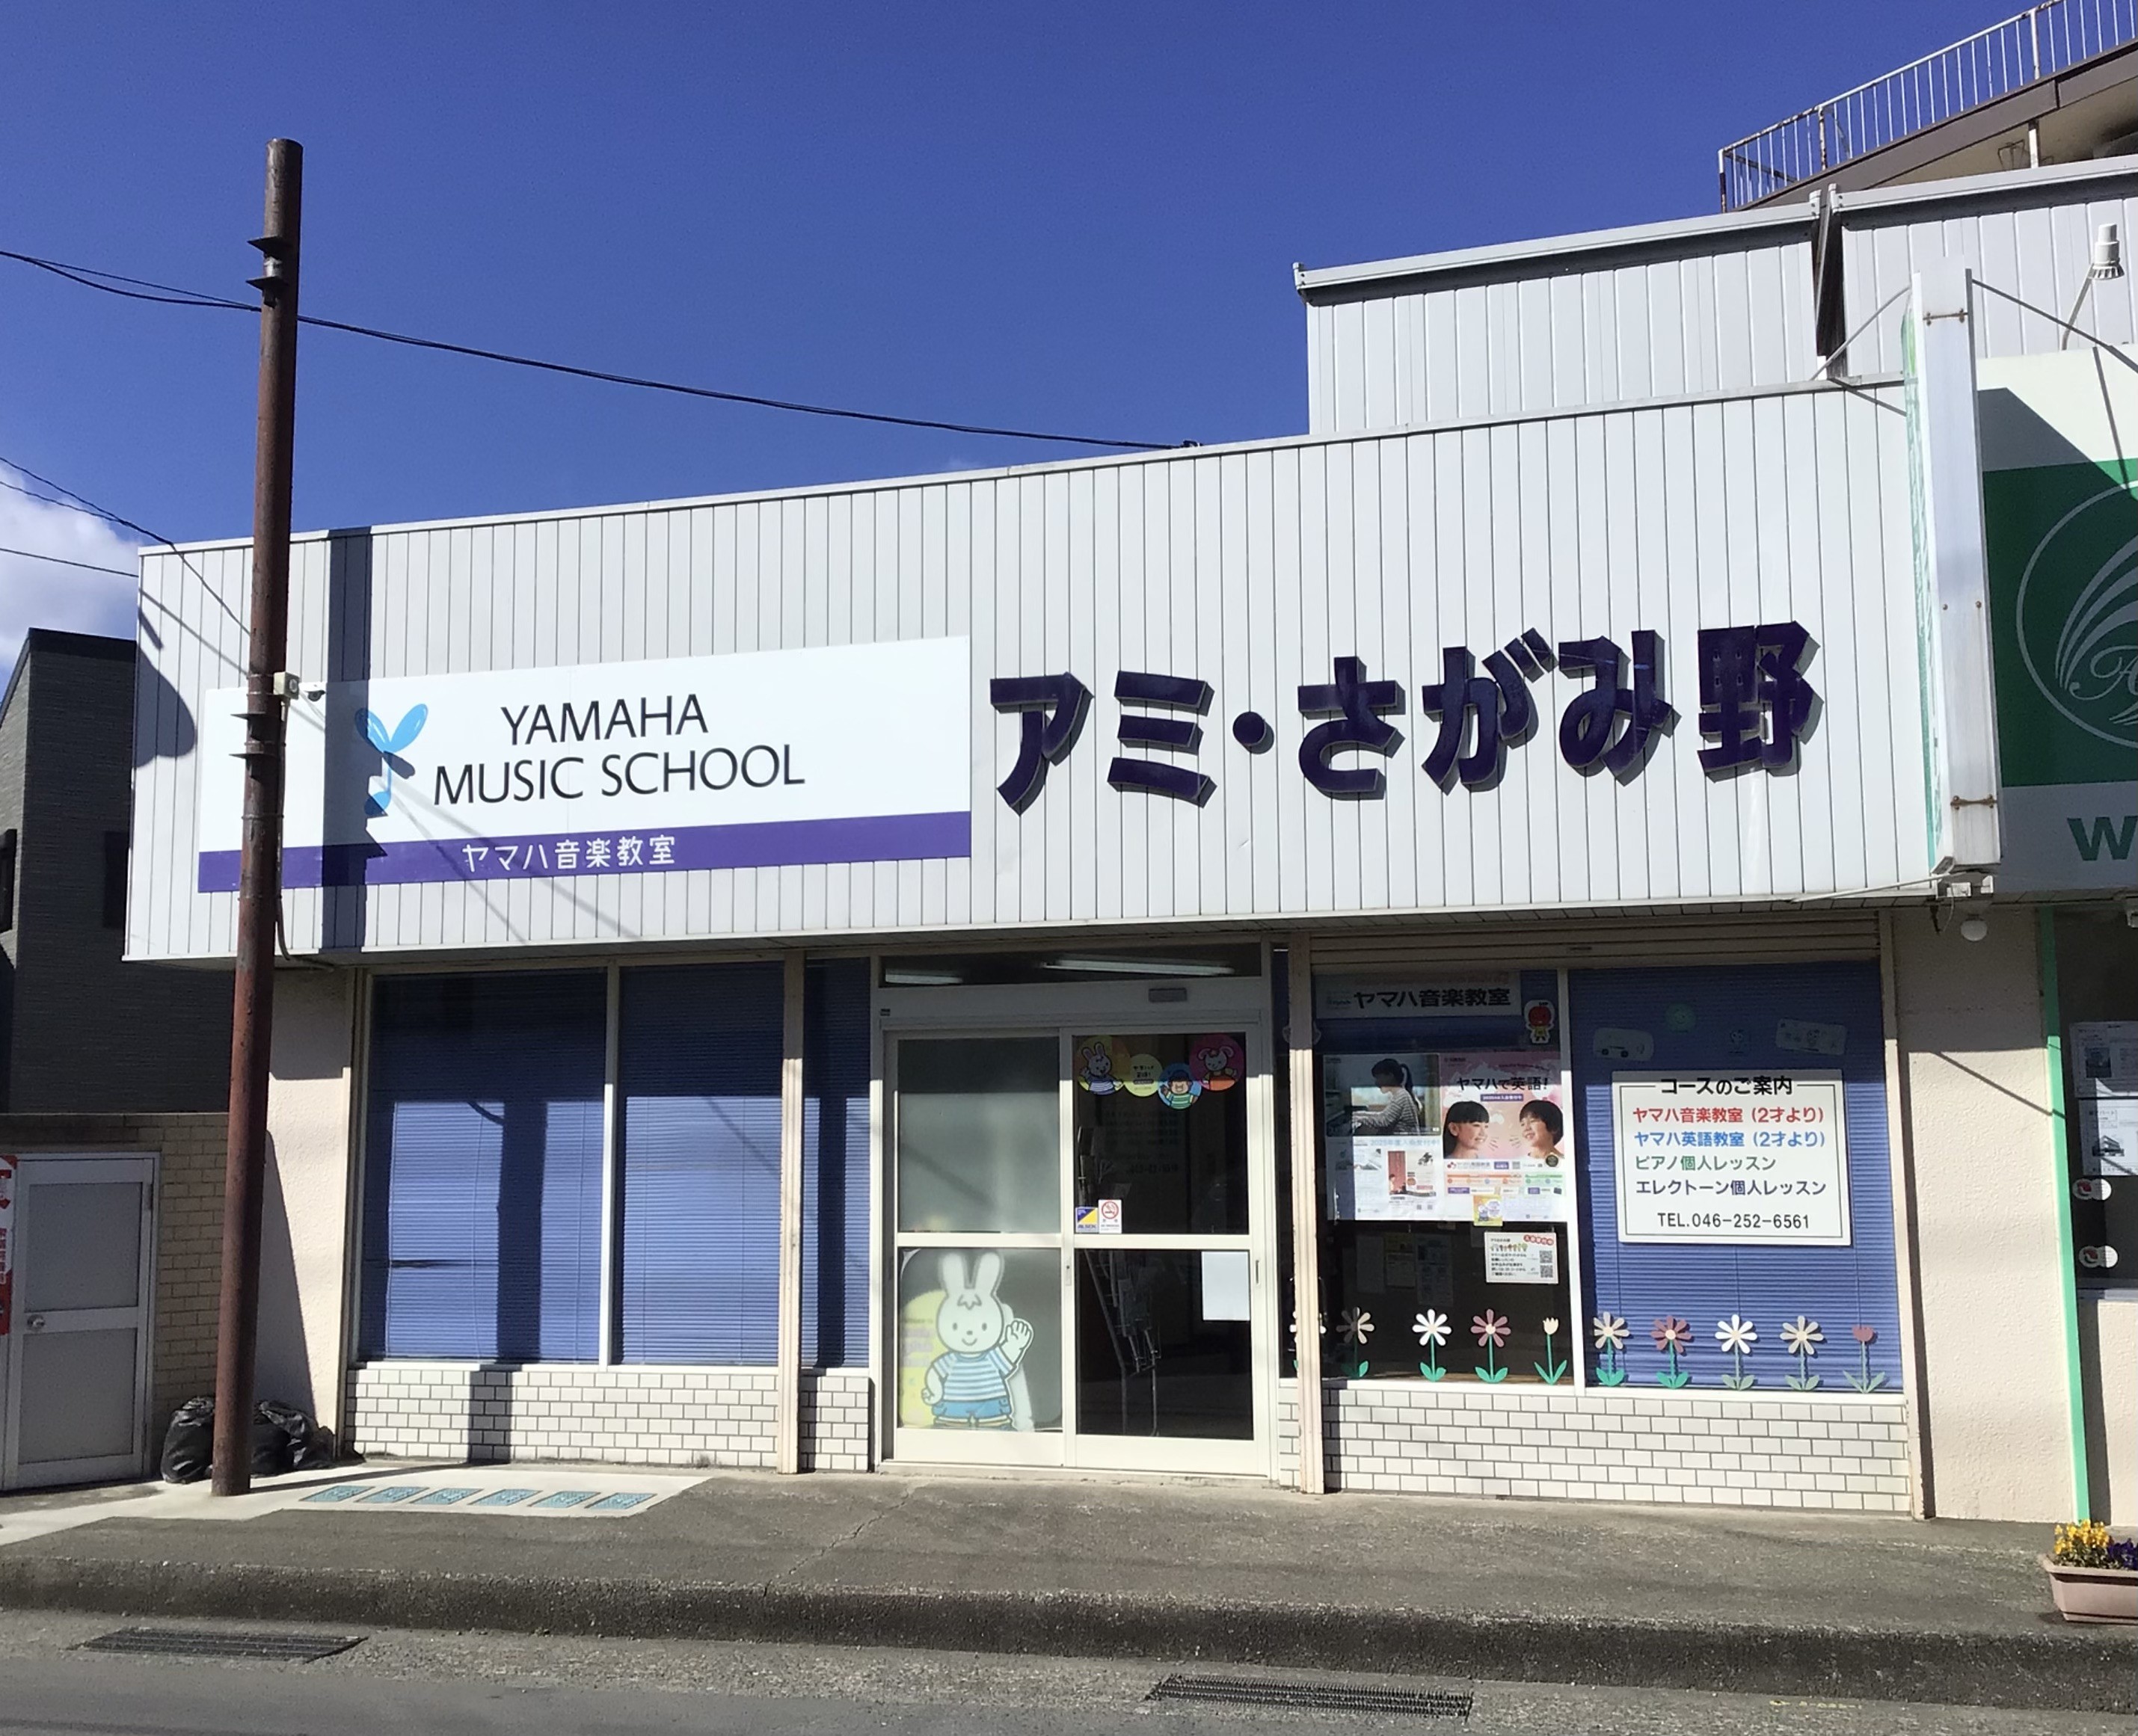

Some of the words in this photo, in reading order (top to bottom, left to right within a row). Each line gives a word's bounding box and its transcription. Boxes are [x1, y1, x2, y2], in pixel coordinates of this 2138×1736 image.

[501, 693, 709, 746] YAMAHA
[990, 621, 1820, 815] アミ・さがみ野
[434, 755, 584, 806] MUSIC
[600, 743, 805, 796] SCHOOL
[461, 834, 677, 872] ヤマハ音楽教室
[1353, 988, 1511, 1009] ヤマハ音楽教室
[1456, 1076, 1549, 1091] ヤマハで英語!
[1661, 1075, 1793, 1096] コースのご案内
[1635, 1155, 1777, 1171] ピアノ個人レッスン
[1635, 1179, 1827, 1196] エレクトーン個人レッスン
[1657, 1212, 1810, 1229] TEL.046-252-6561
